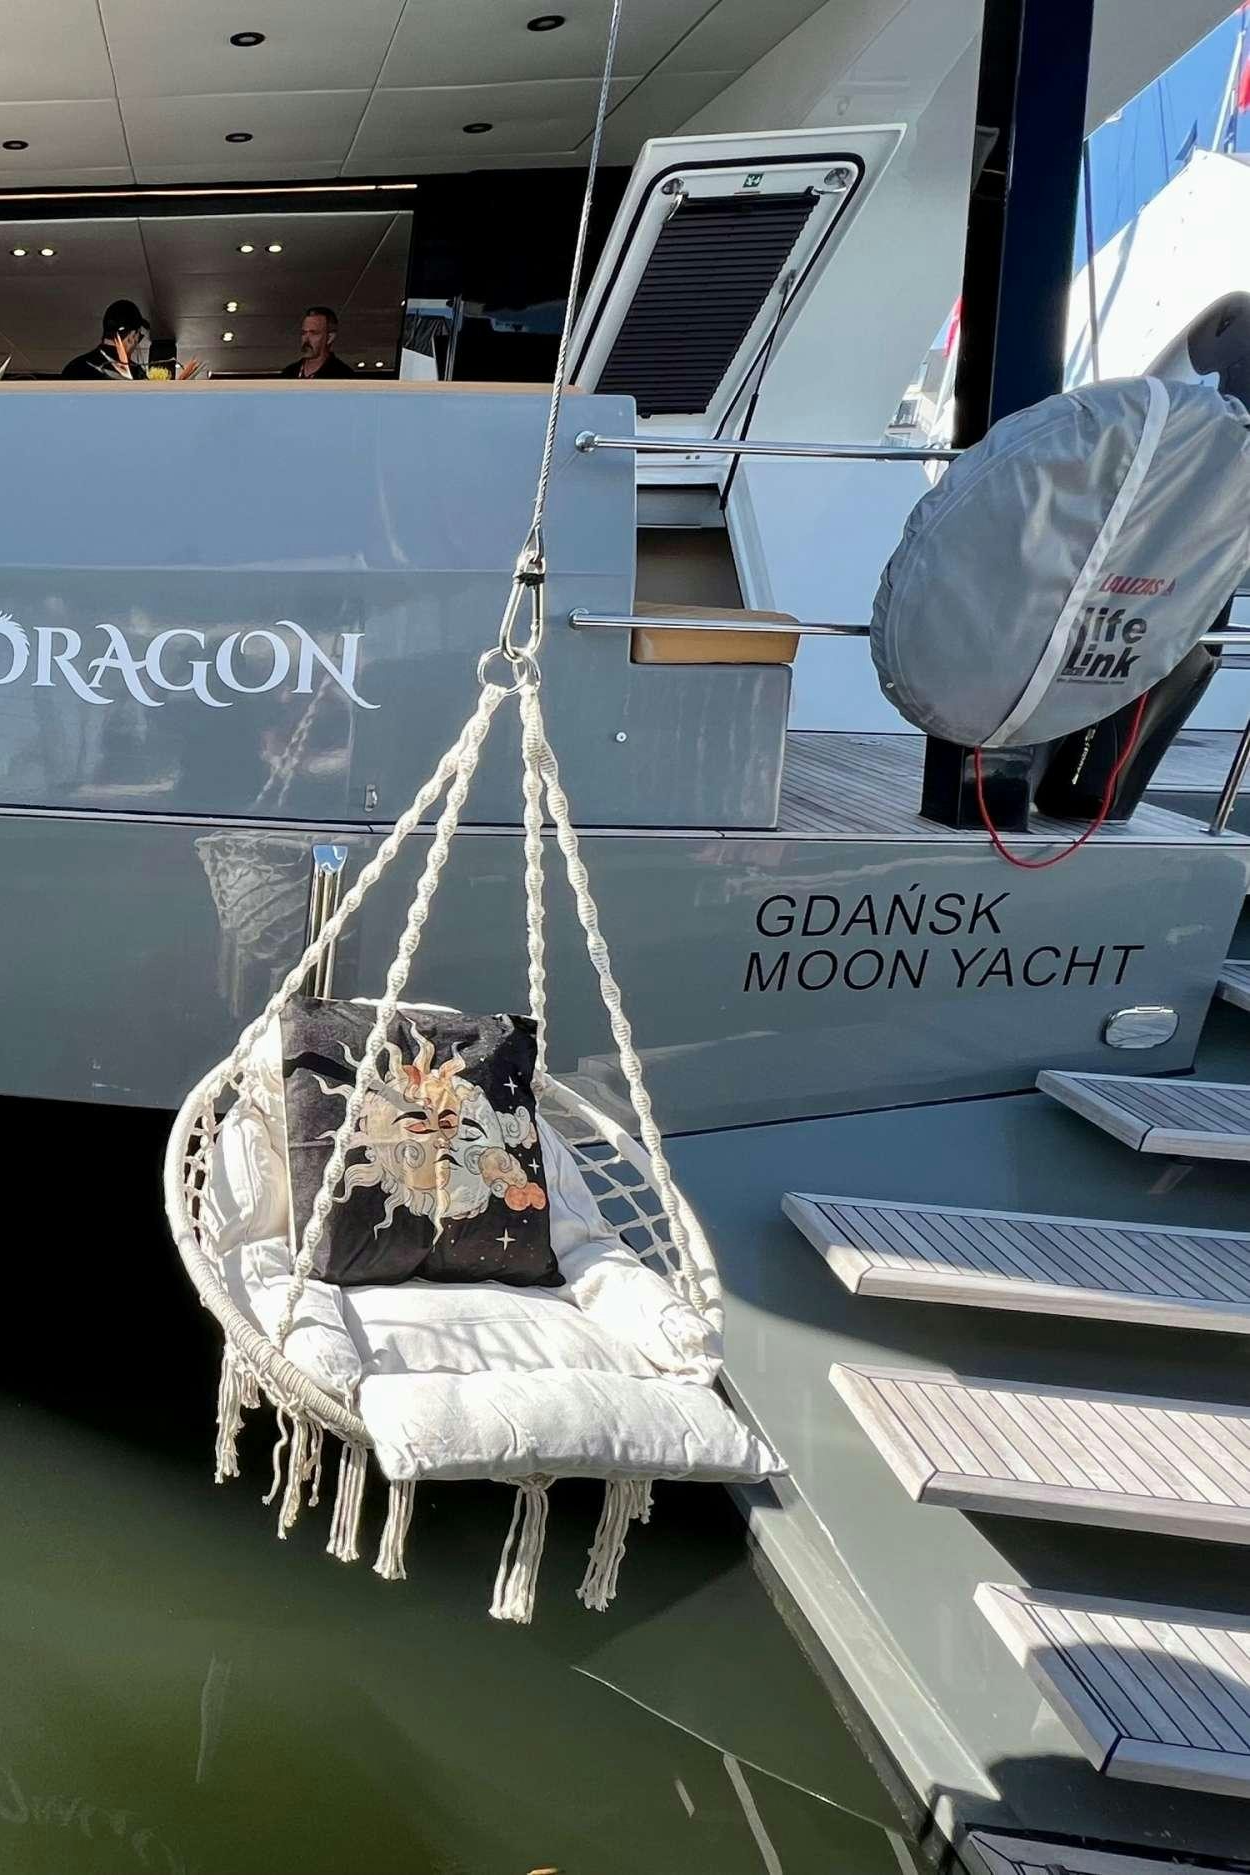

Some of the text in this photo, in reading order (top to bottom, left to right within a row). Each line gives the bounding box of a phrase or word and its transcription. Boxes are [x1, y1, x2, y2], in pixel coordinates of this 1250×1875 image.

[1084, 607, 1147, 643] life
[755, 883, 1011, 937] GDAŃSK
[743, 945, 1145, 992] MOON YACHT
